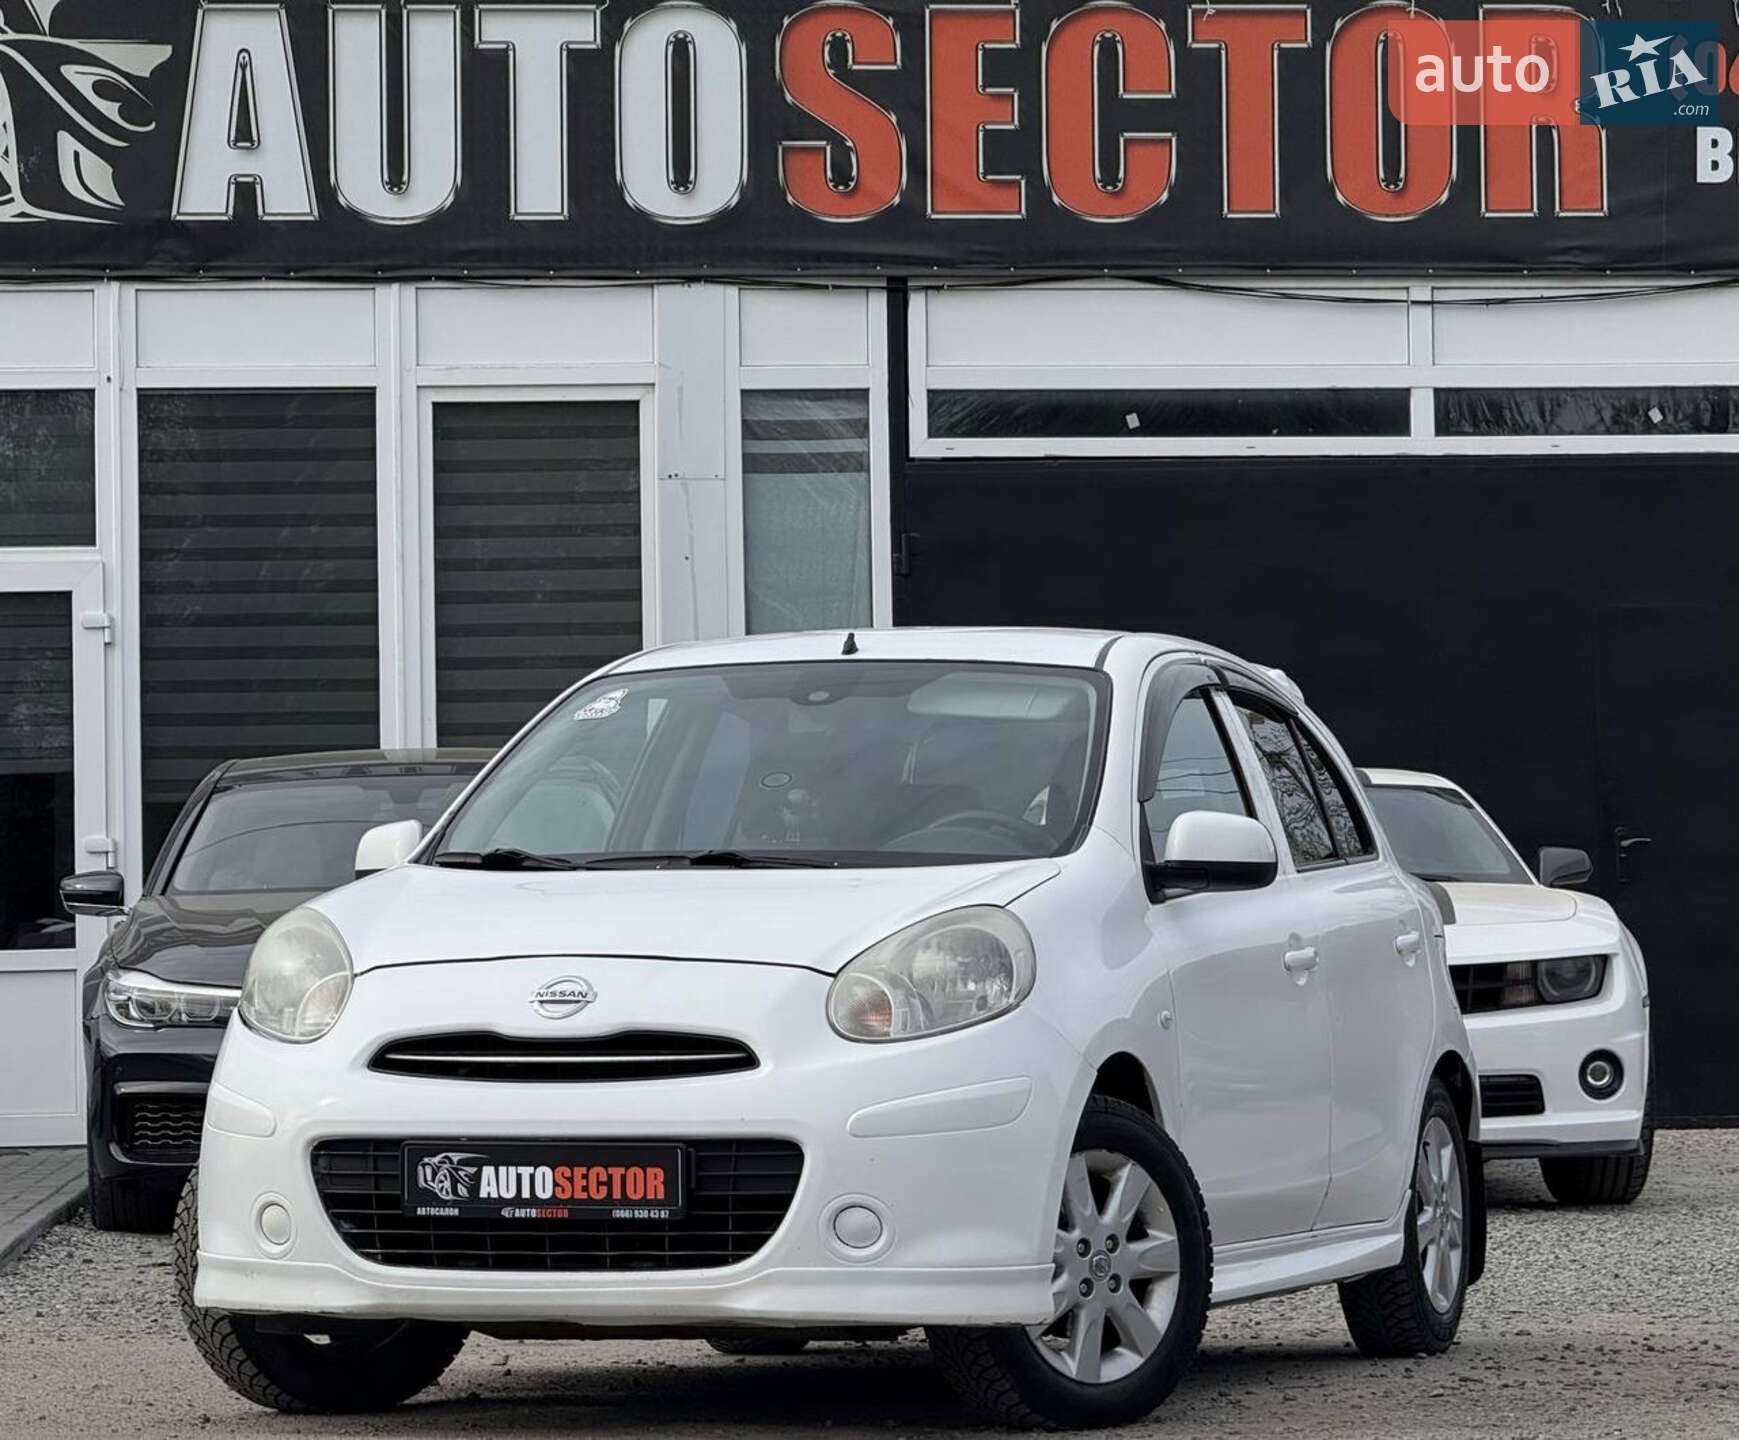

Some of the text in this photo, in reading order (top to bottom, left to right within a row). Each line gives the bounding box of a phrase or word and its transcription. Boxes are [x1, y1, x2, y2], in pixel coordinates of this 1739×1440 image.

[171, 1, 1609, 224] AUTOSECTOR
[535, 990, 588, 999] NISSAN
[479, 1165, 665, 1200] AUTOSECTOR
[514, 1208, 569, 1218] AUTOSECTOR
